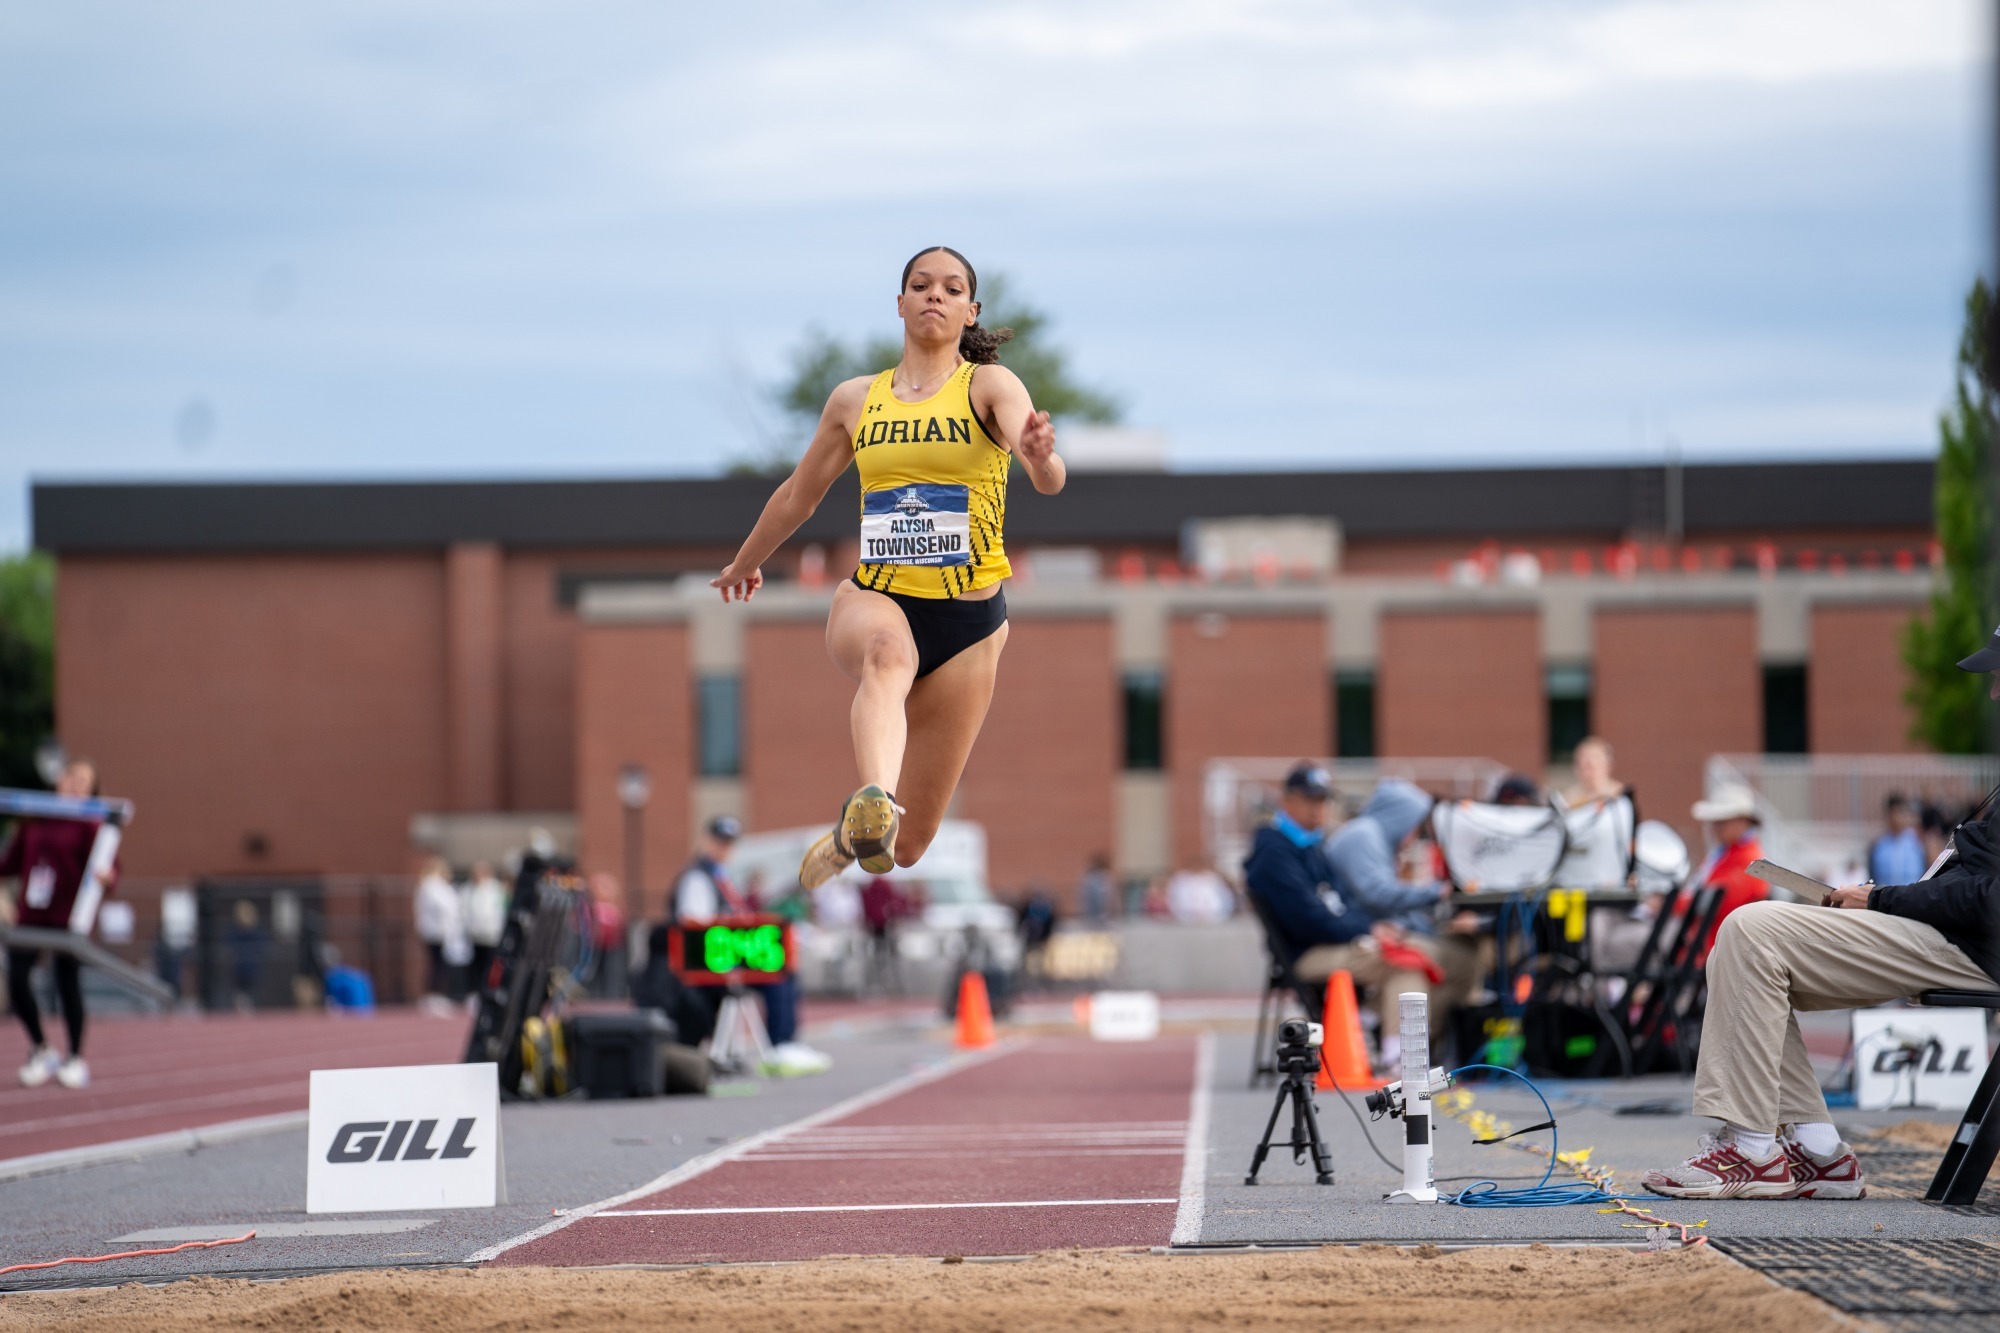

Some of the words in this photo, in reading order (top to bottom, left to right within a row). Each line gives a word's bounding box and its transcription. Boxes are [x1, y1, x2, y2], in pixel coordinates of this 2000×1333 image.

[855, 417, 972, 452] ADRIAN
[890, 518, 935, 533] ALYSIA
[867, 534, 961, 557] TOWNSEND
[914, 556, 943, 565] WISCONSIN
[1872, 1046, 1974, 1073] GLL
[326, 1117, 477, 1164] GILL
